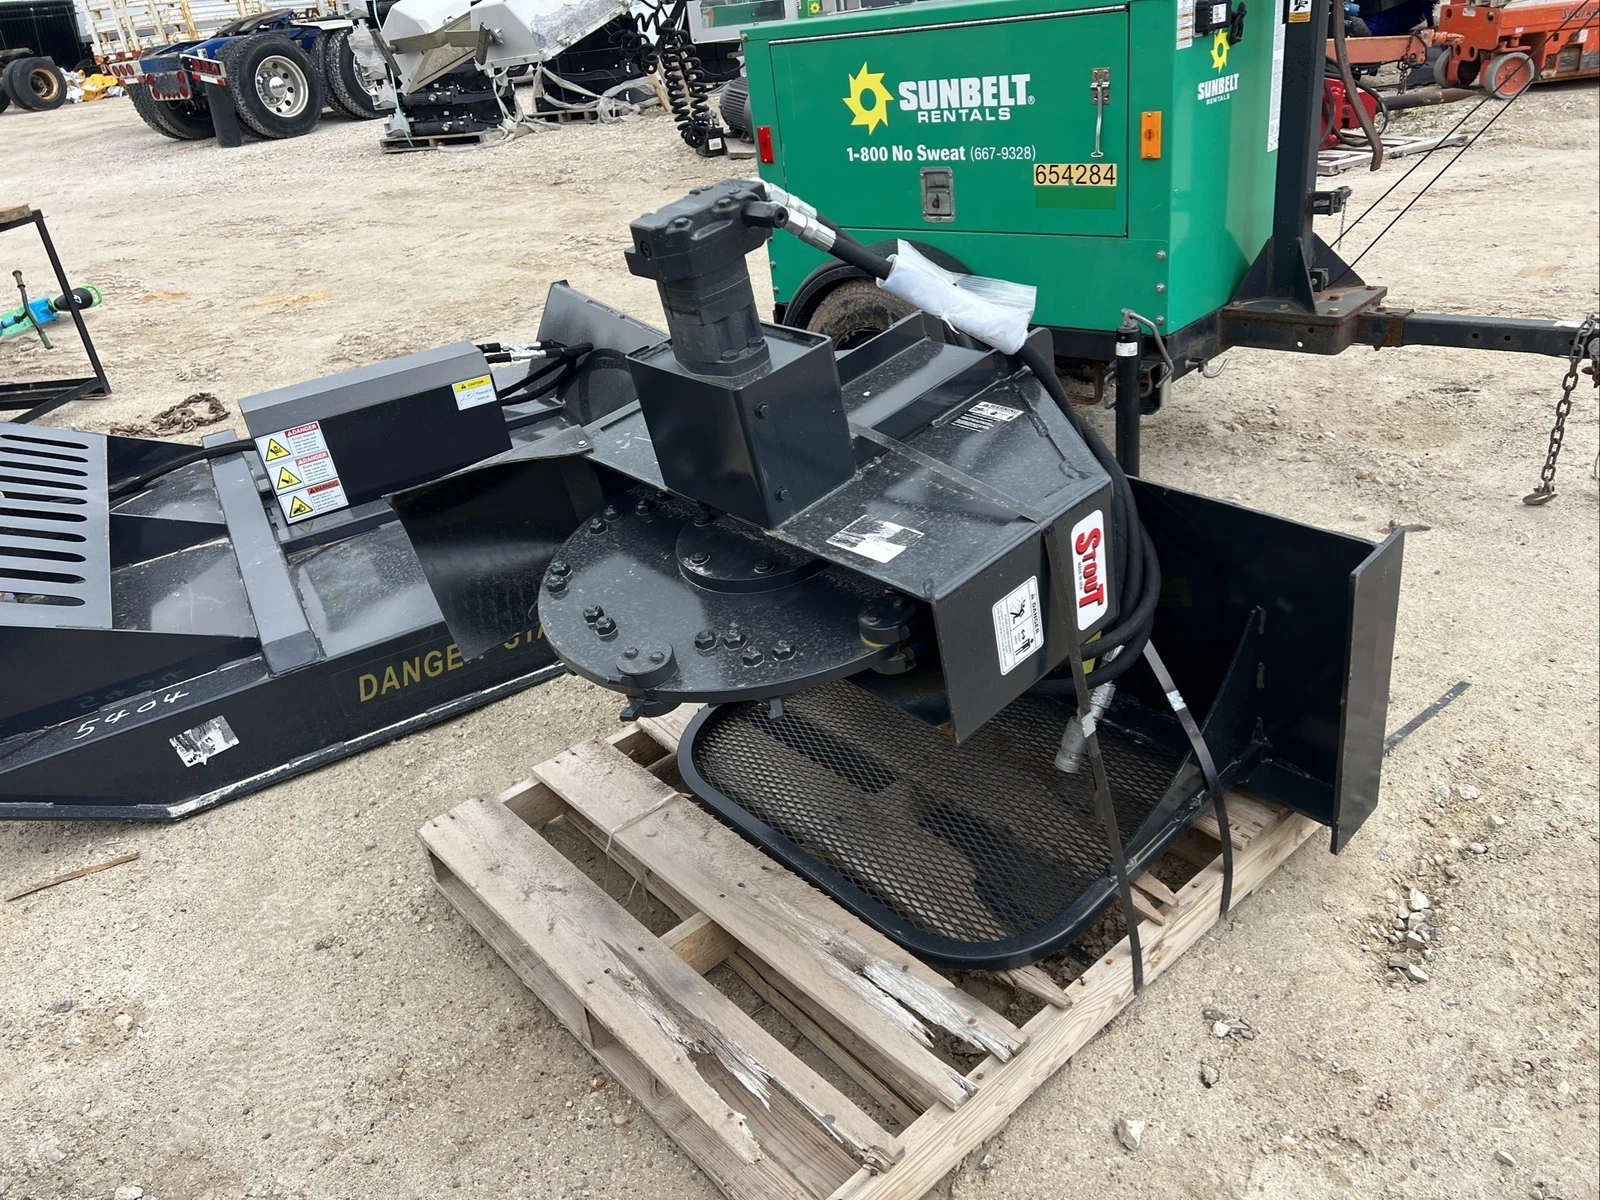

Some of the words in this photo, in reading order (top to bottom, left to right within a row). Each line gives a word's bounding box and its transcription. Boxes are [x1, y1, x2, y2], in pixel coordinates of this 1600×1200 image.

[1197, 73, 1240, 101] SUNBELT
[1206, 93, 1231, 105] RENTALS
[918, 107, 1011, 123] RENTALS
[846, 146, 888, 161] 1-800
[892, 145, 914, 161] No
[917, 144, 966, 161] Sweat
[970, 144, 1036, 162] (667-9328)
[1035, 164, 1116, 185] 654284
[292, 424, 318, 435] DANGER
[302, 452, 328, 464] DANGER
[1075, 528, 1104, 608] STOUT
[1031, 602, 1040, 634] DANGER
[358, 642, 484, 703] DANGE
[73, 691, 190, 740] 5404
